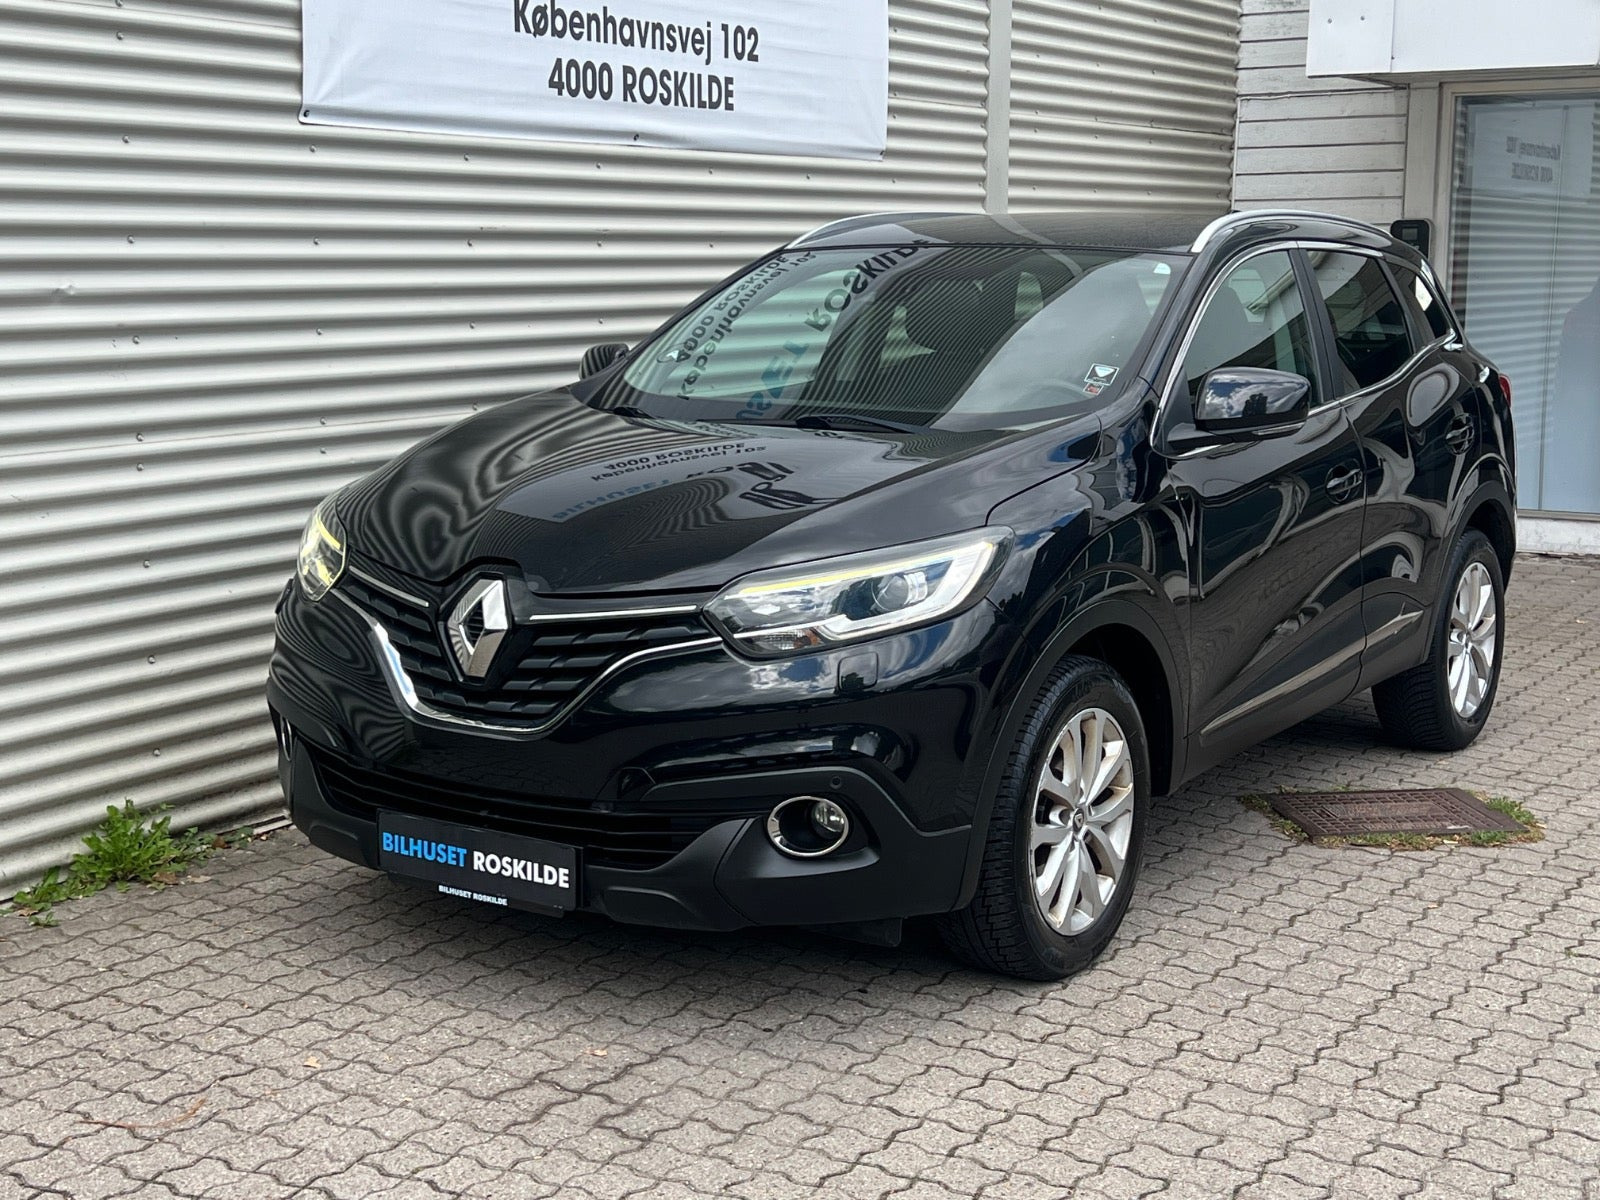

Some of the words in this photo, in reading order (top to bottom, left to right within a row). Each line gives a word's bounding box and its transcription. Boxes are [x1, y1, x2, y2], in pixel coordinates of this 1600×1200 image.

[514, 0, 712, 66] Københavnsvej
[721, 23, 760, 63] 102
[548, 57, 614, 102] 4000
[622, 65, 735, 112] ROSKILDE
[381, 831, 467, 868] BILHUSET
[472, 850, 570, 889] ROSKILDE
[438, 884, 472, 899] BILHUSET
[472, 892, 508, 907] ROSKILDE
